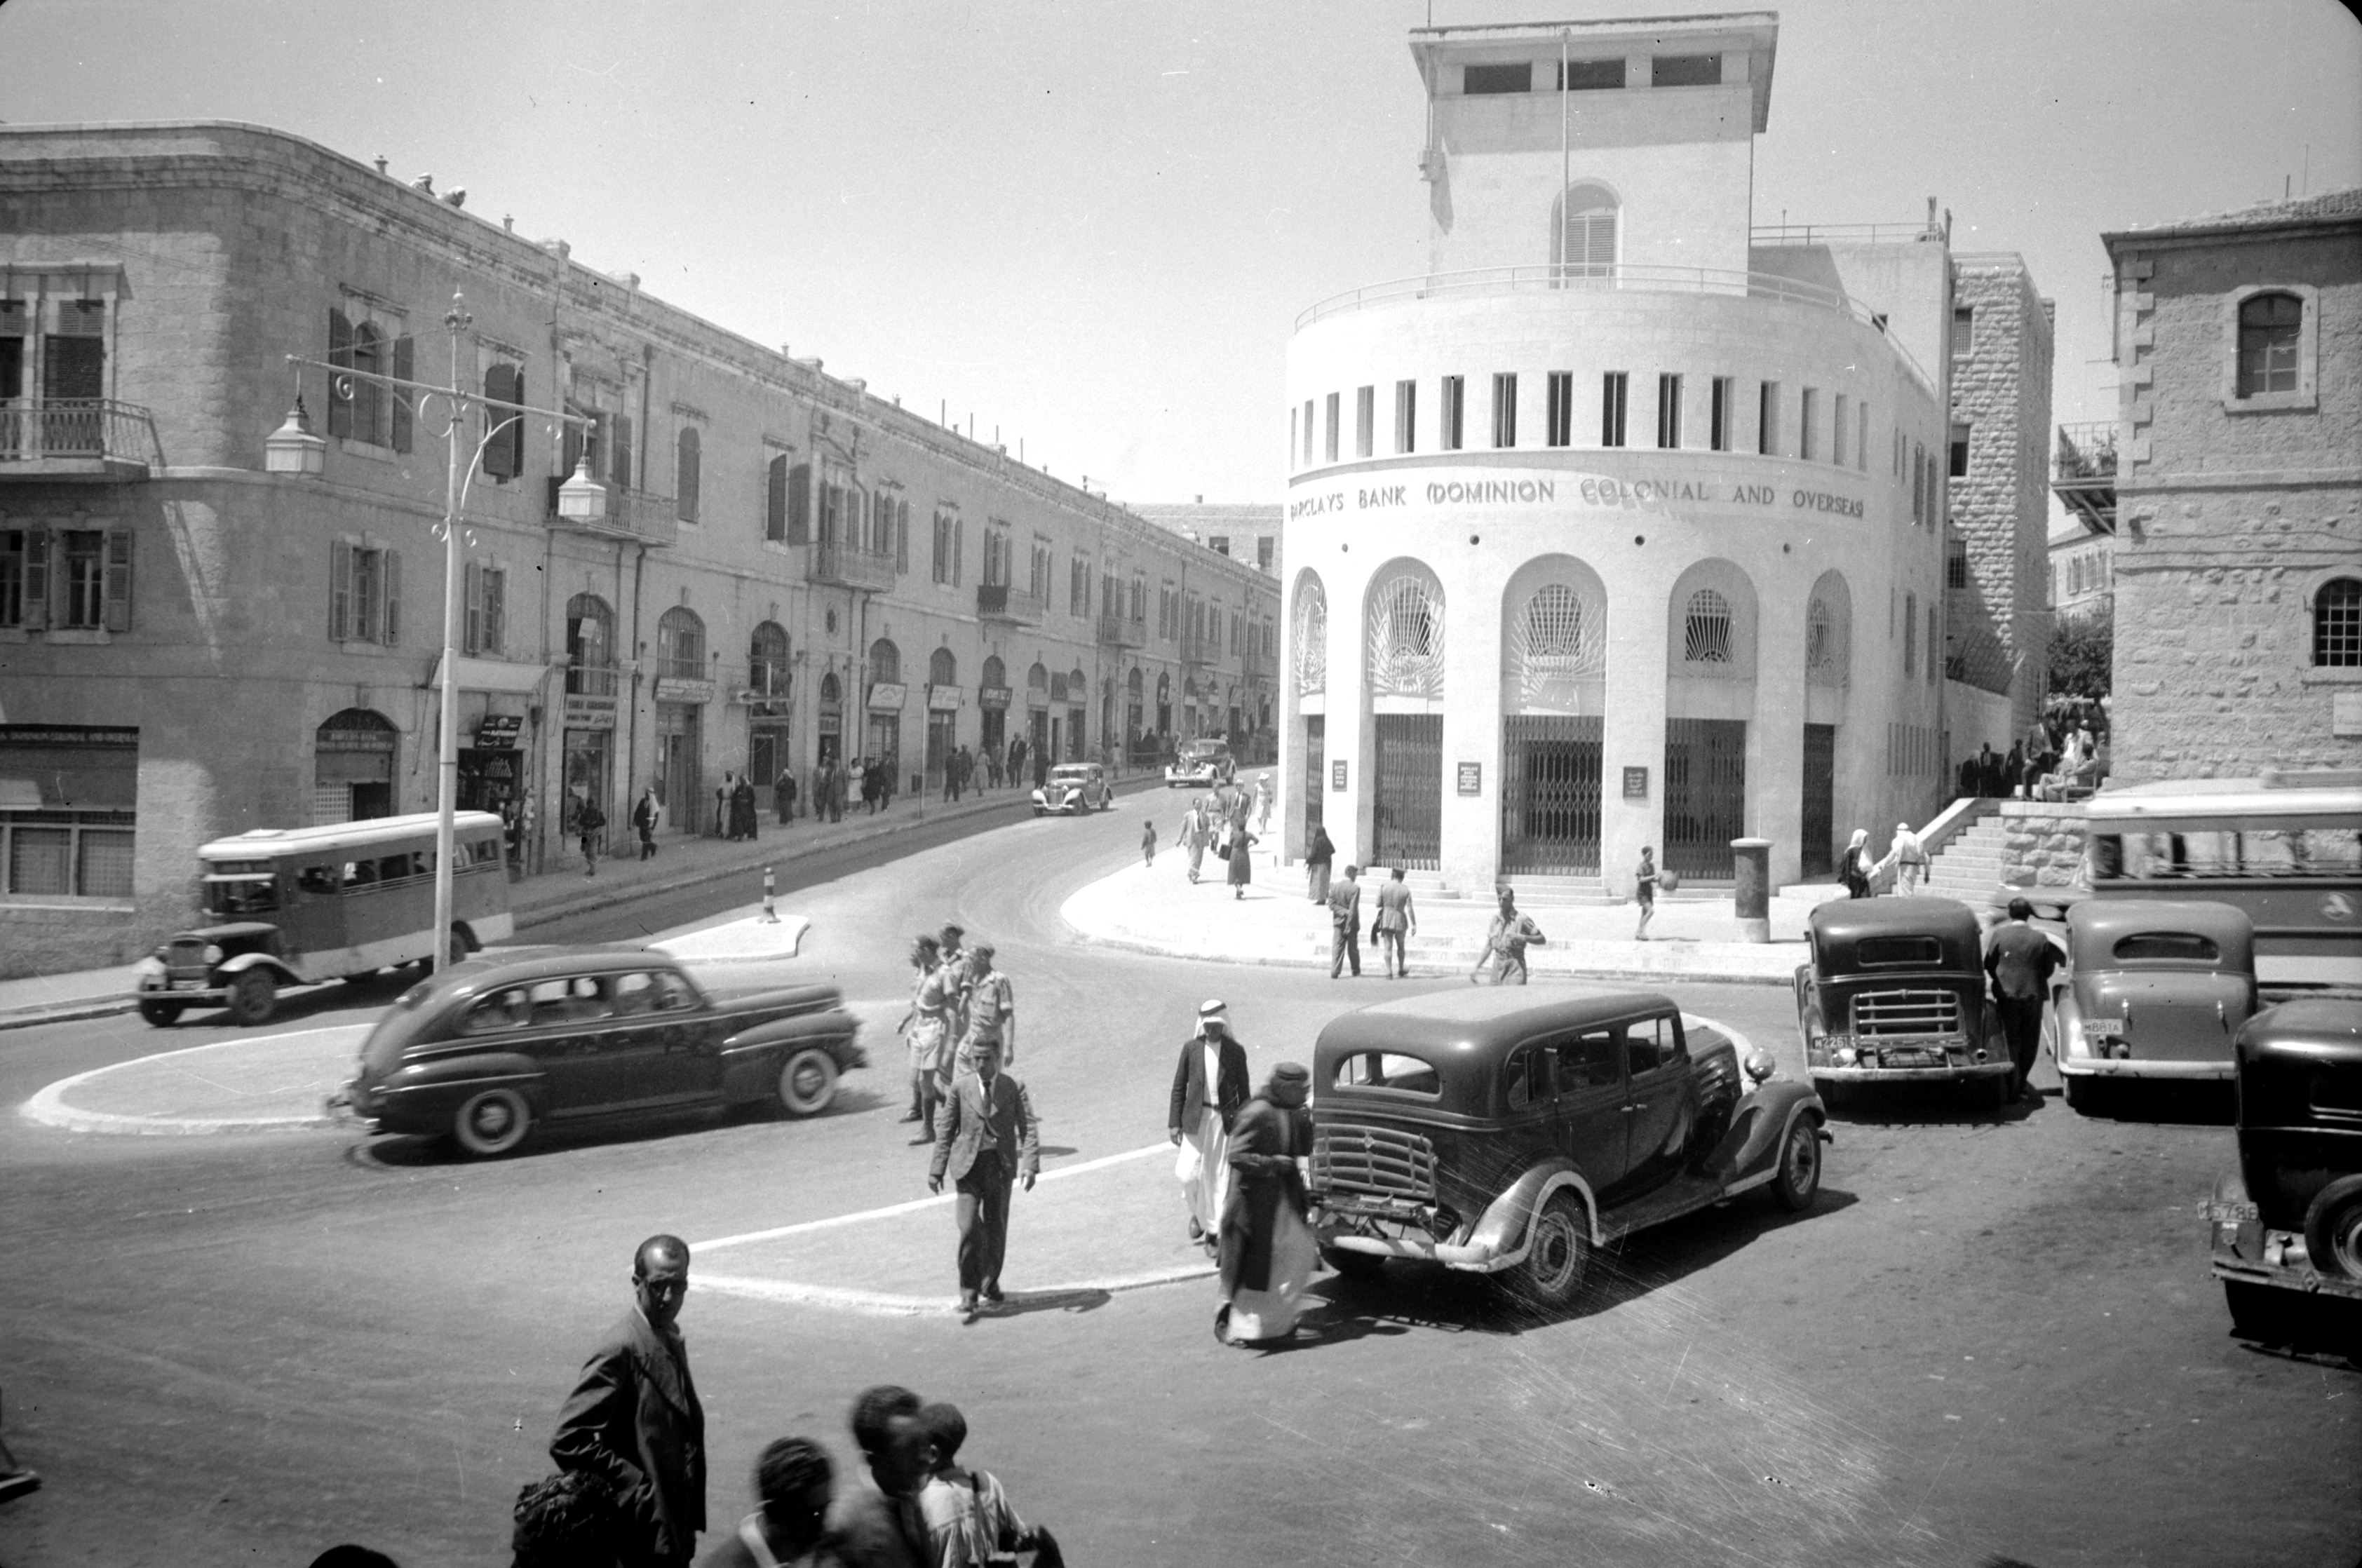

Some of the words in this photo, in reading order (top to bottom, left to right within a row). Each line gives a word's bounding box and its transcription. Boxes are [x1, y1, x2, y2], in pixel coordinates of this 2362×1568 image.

[1290, 492, 1344, 522] BARCLAYS
[1358, 485, 1407, 510] BANK
[1580, 478, 1710, 501] COLONIAL
[1733, 485, 1775, 505] AND
[2084, 1022, 2120, 1032] M881A
